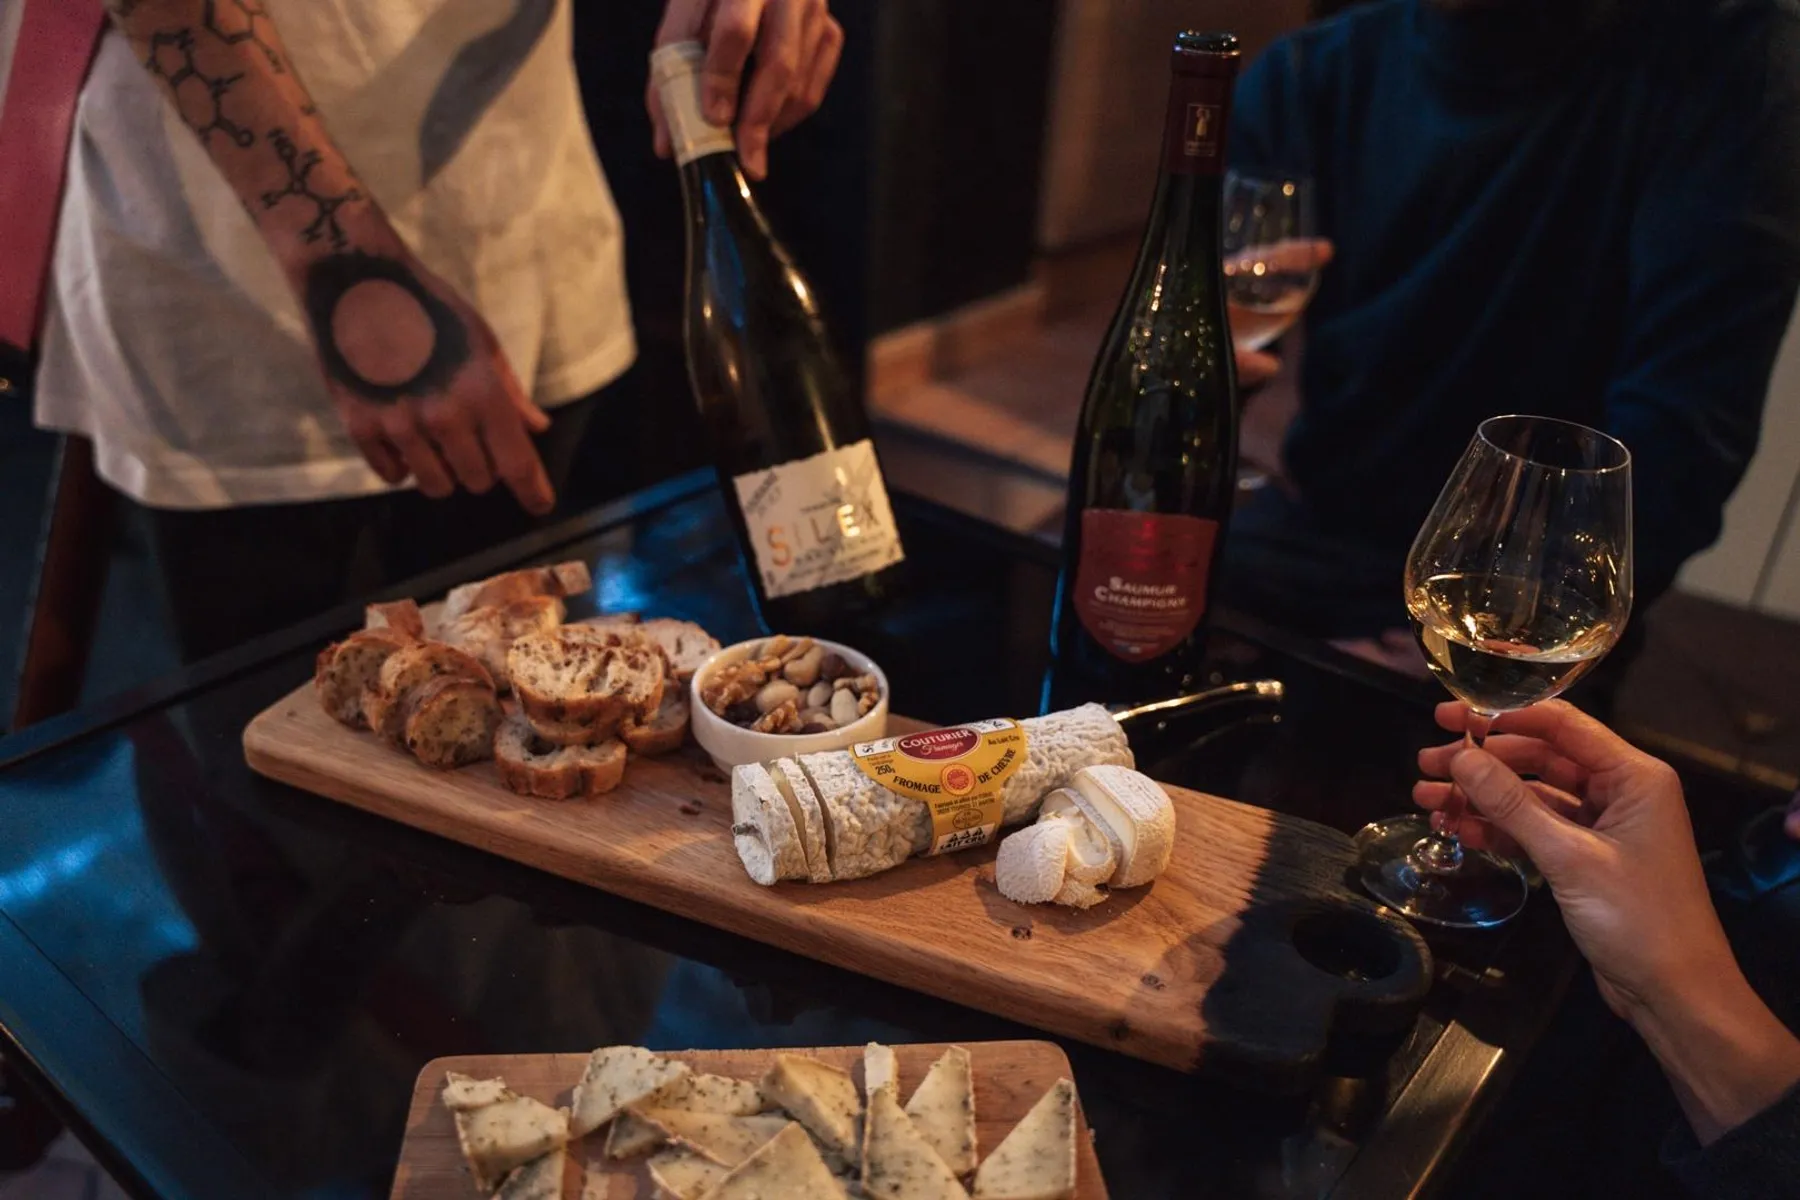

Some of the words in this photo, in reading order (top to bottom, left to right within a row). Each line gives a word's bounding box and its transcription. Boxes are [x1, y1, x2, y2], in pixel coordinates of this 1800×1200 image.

[767, 501, 880, 567] SILEX
[1109, 576, 1176, 596] SAUMUR
[1094, 586, 1186, 609] CHAMPIGNY
[900, 729, 972, 749] COUTURIER
[893, 776, 941, 794] FROMAGE
[978, 772, 992, 784] DE
